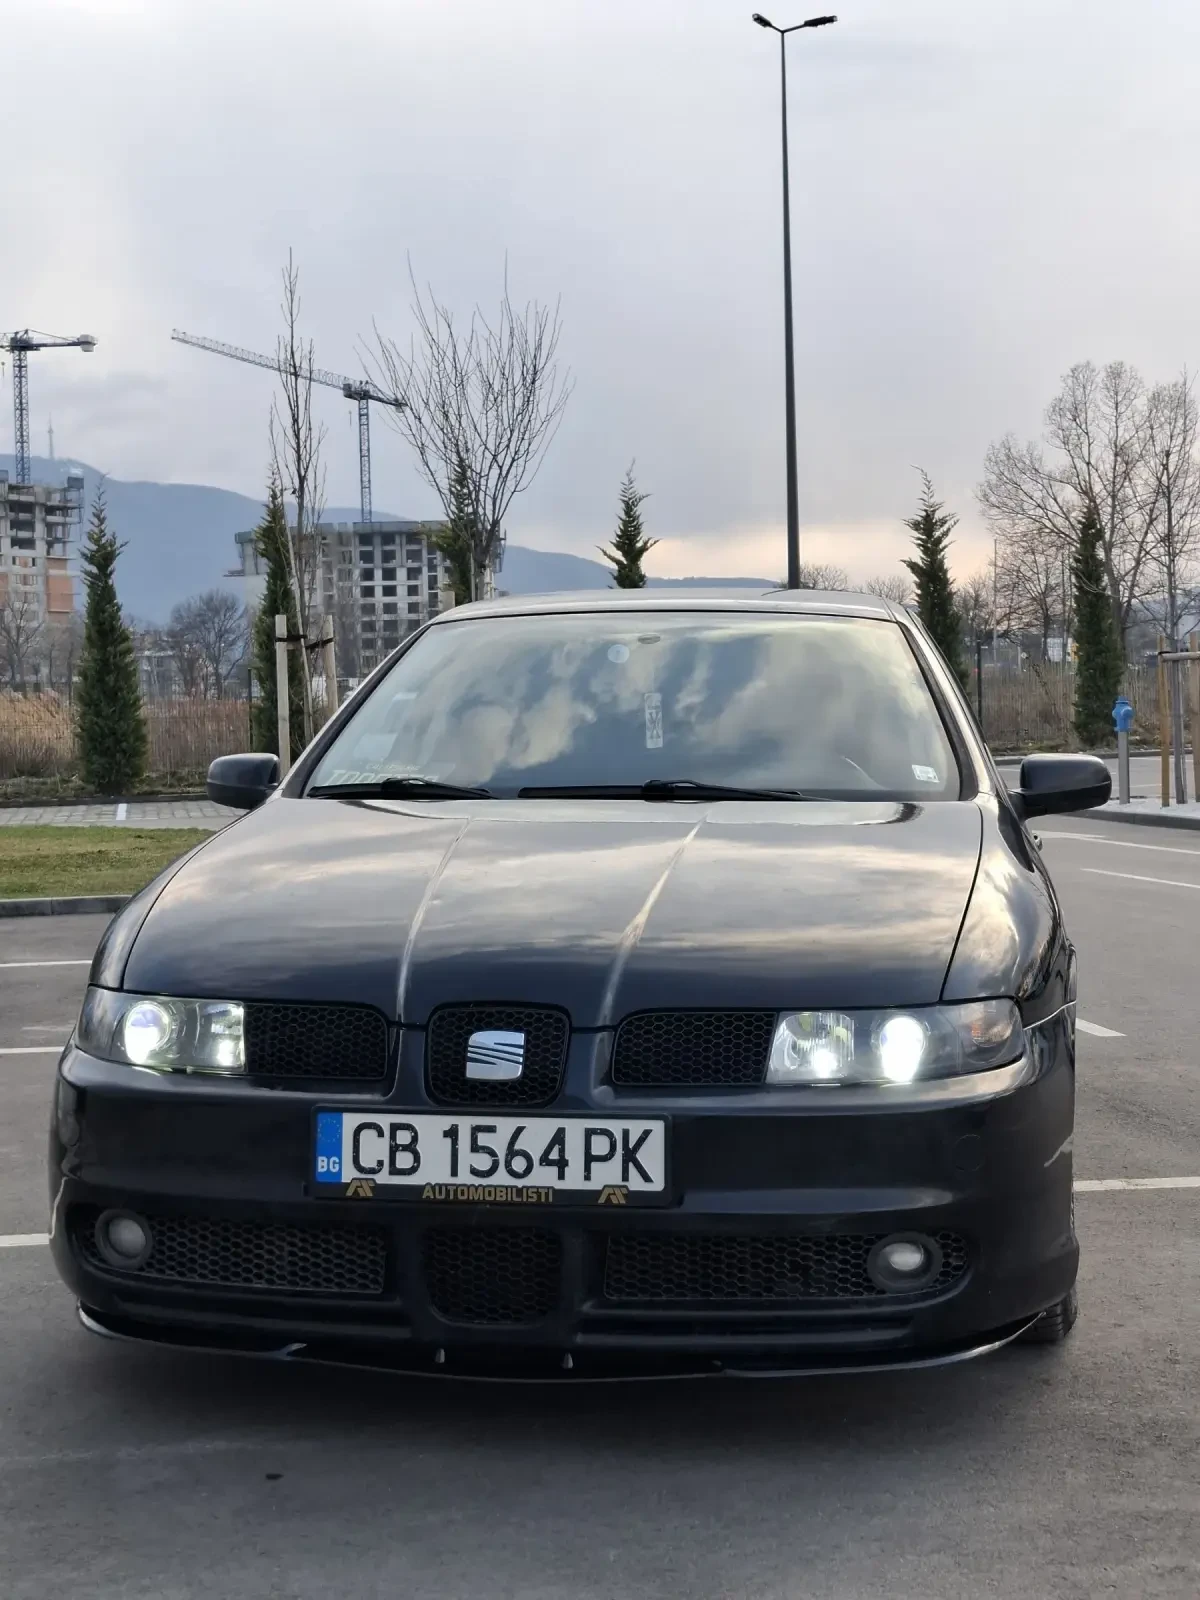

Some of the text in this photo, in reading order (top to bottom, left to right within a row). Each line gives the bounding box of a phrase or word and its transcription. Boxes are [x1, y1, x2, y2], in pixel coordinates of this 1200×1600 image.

[352, 1121, 655, 1184] CB 1564 PK
[317, 1156, 340, 1173] BG
[422, 1184, 553, 1203] AUTOMOBILISTI
